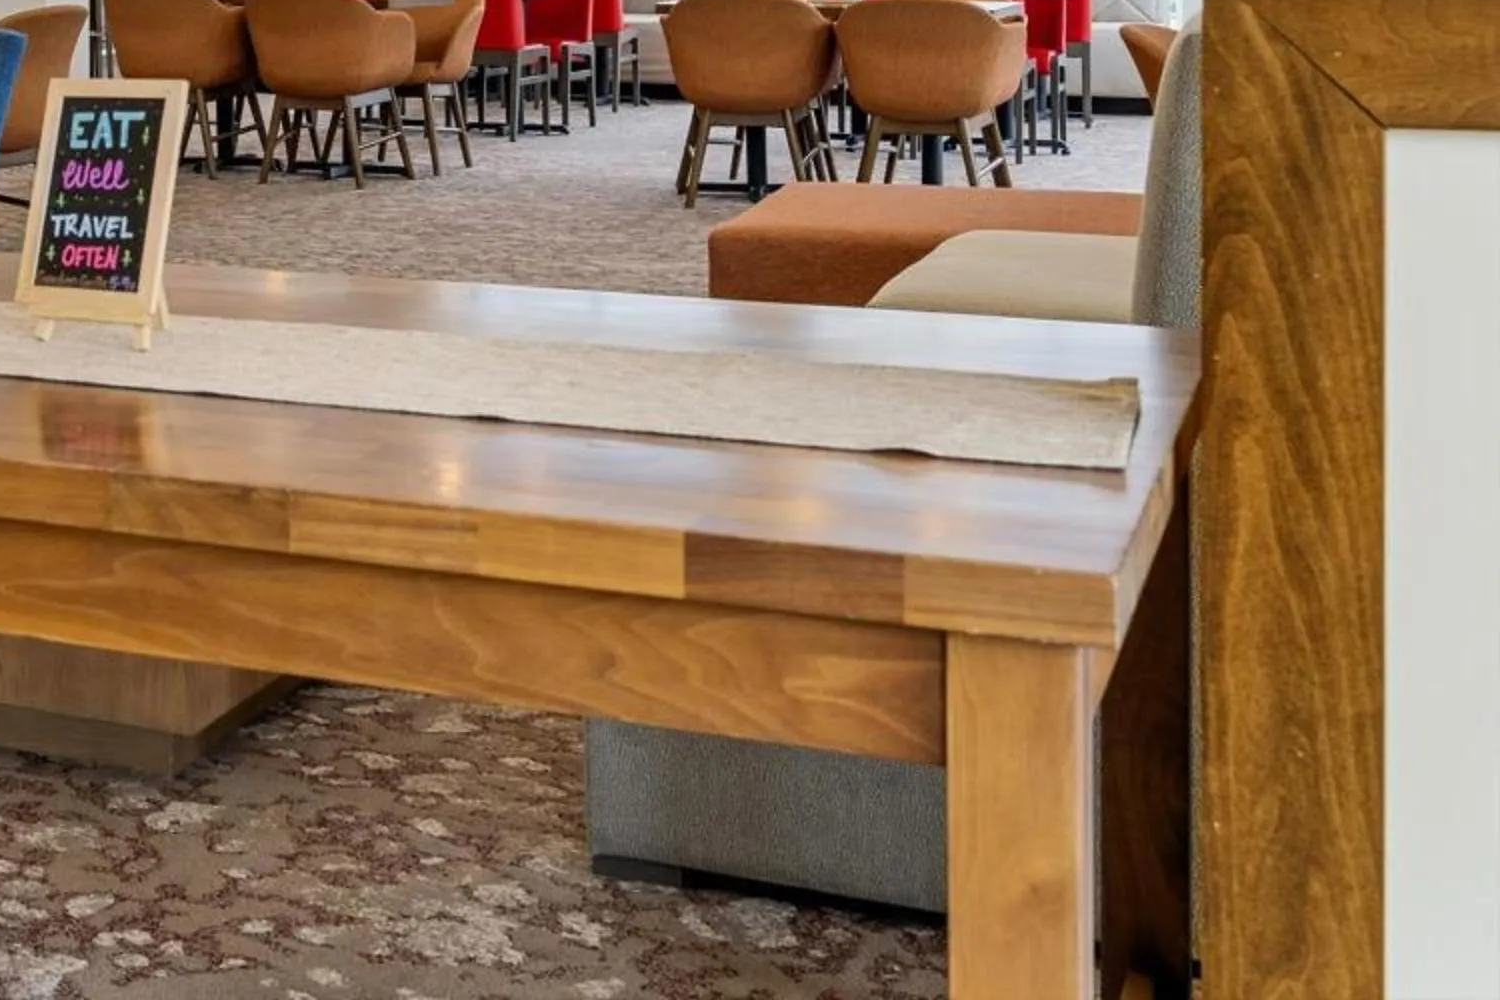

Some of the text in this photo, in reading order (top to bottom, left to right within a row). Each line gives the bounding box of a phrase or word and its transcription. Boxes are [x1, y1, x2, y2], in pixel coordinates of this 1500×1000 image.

[69, 111, 147, 150] EAT
[51, 212, 134, 238] TRAVEL
[61, 243, 120, 270] OFTEN
